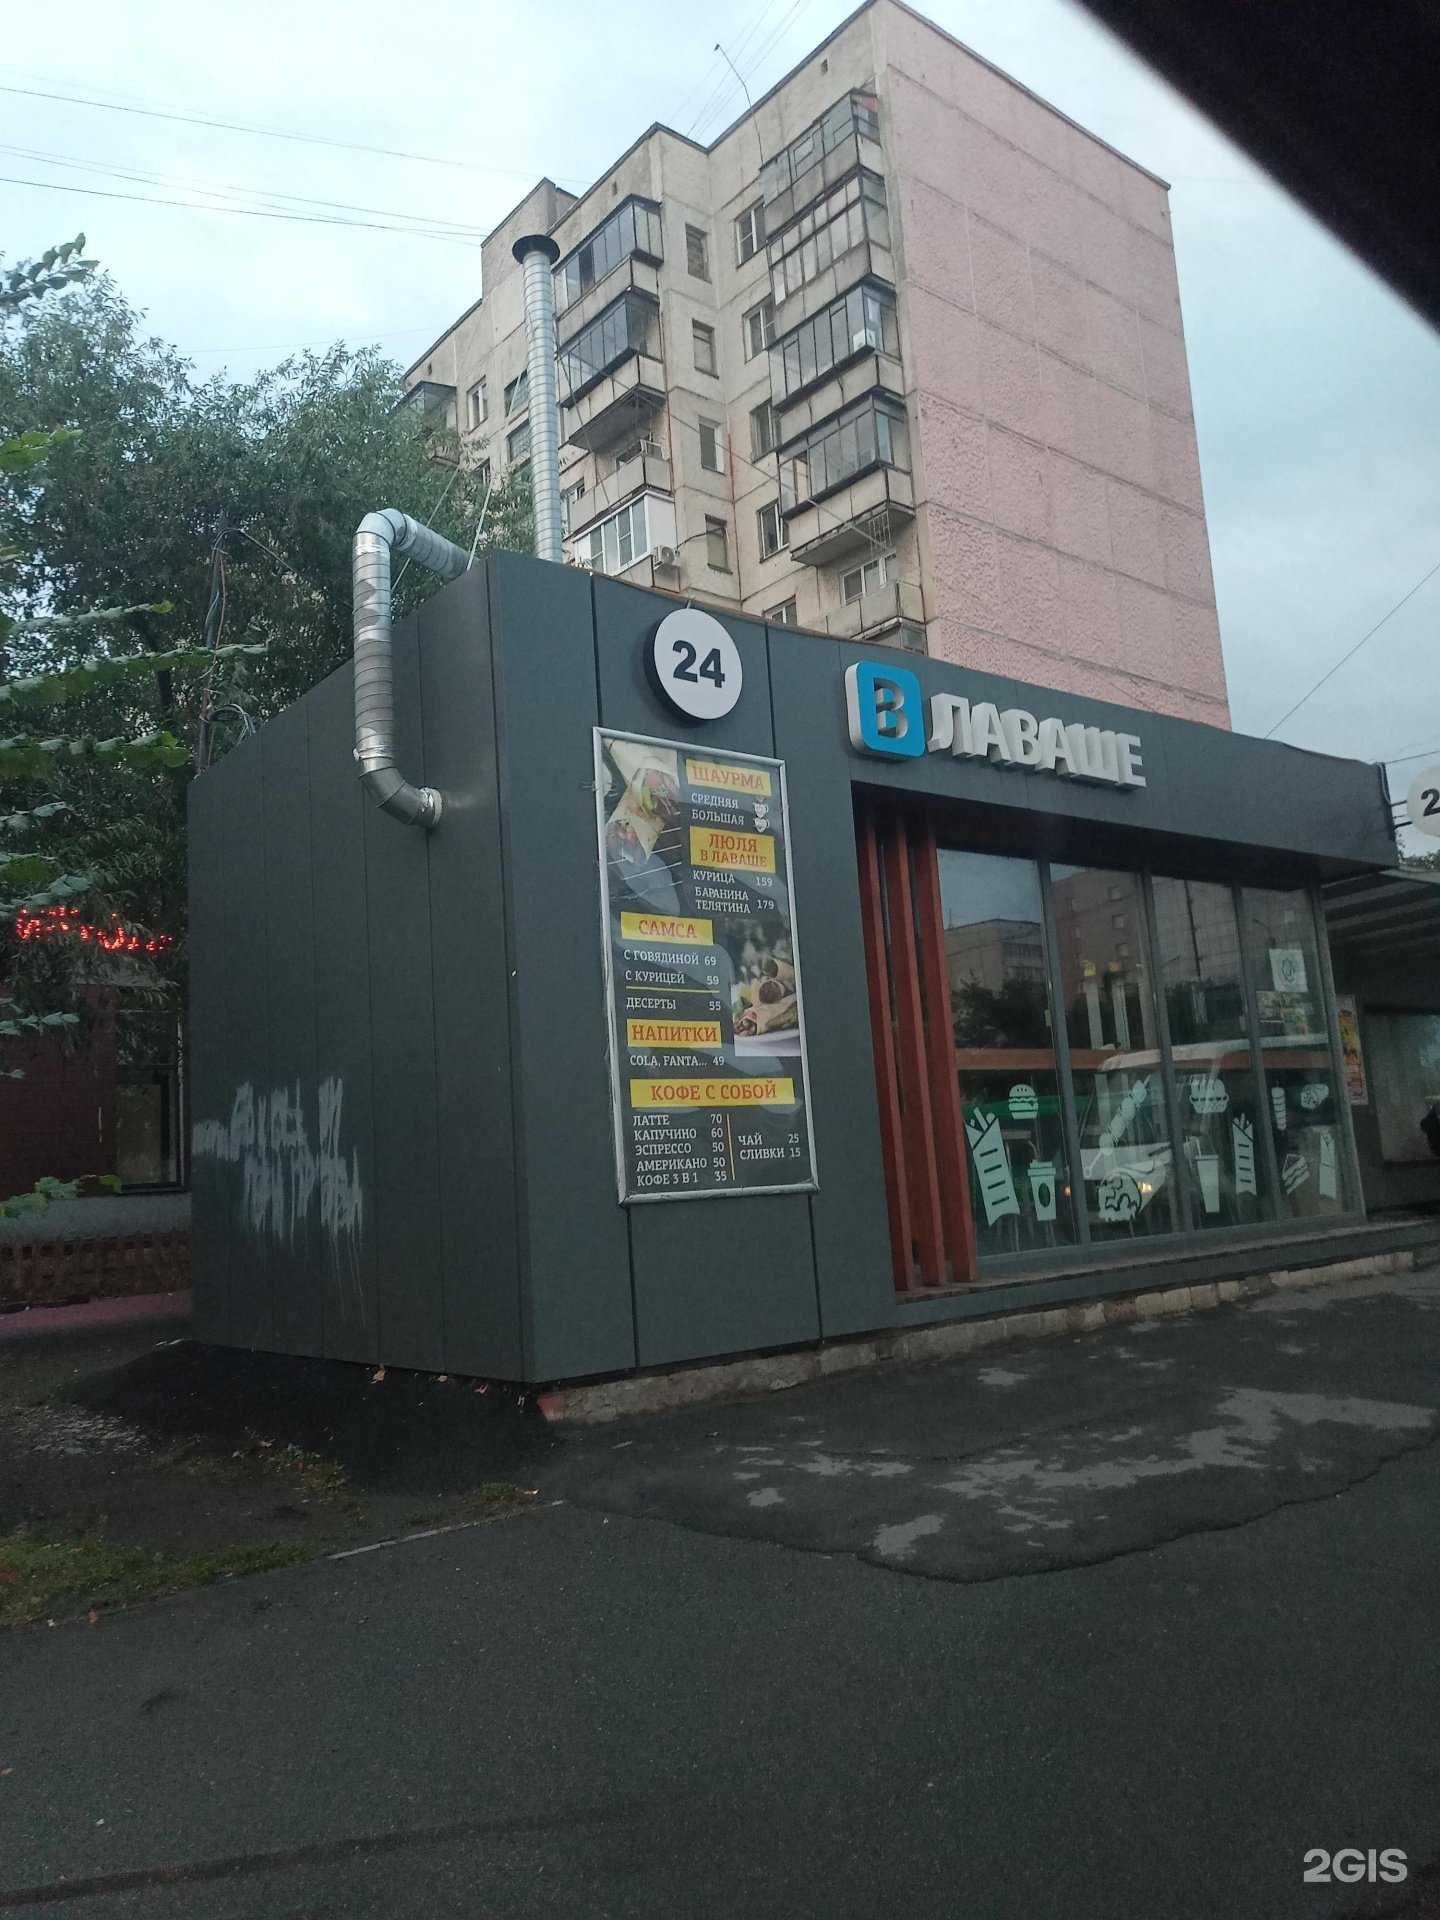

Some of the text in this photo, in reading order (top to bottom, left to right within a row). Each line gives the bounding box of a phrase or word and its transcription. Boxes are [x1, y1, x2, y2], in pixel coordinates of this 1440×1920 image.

[672, 639, 725, 688] 24
[873, 677, 1147, 790] В ЛАВАШЕ
[692, 765, 765, 790] ШАУРМА
[691, 793, 739, 809] СРЕДНЯЯ
[692, 810, 745, 825] БОЛЬШАЯ
[709, 833, 757, 852] ЛЮЛЯ
[700, 850, 768, 867] В ЛАВАШЕ
[693, 871, 773, 887] КУРИЦА 159
[695, 887, 749, 901] БАРАНИНА
[696, 899, 775, 914] ТЕЛЯТИНА 179
[638, 920, 697, 939] САМСА
[624, 949, 716, 966] С ГОВЯДИНОЙ 69
[625, 970, 719, 985] С КУРИЦЕЙ 59
[626, 997, 721, 1010] ДЕСЕРТЫ 55
[632, 1025, 718, 1042] НАПИТКИ
[630, 1055, 661, 1067] COLA,
[712, 1056, 725, 1066] 49
[651, 1080, 777, 1101] КОФЕ С СОБОЙ
[633, 1114, 722, 1126] ЛАТТЕ 70
[634, 1128, 723, 1141] КАПУЧИНО 60
[738, 1133, 799, 1146] ЧАЙ 25
[635, 1142, 724, 1155] ЭСПРЕССО 50
[739, 1148, 801, 1161] СЛИВКИ 15
[636, 1157, 725, 1172] АМЕРИКАНО 50
[637, 1171, 727, 1187] КОФЕ 3 В 1 35
